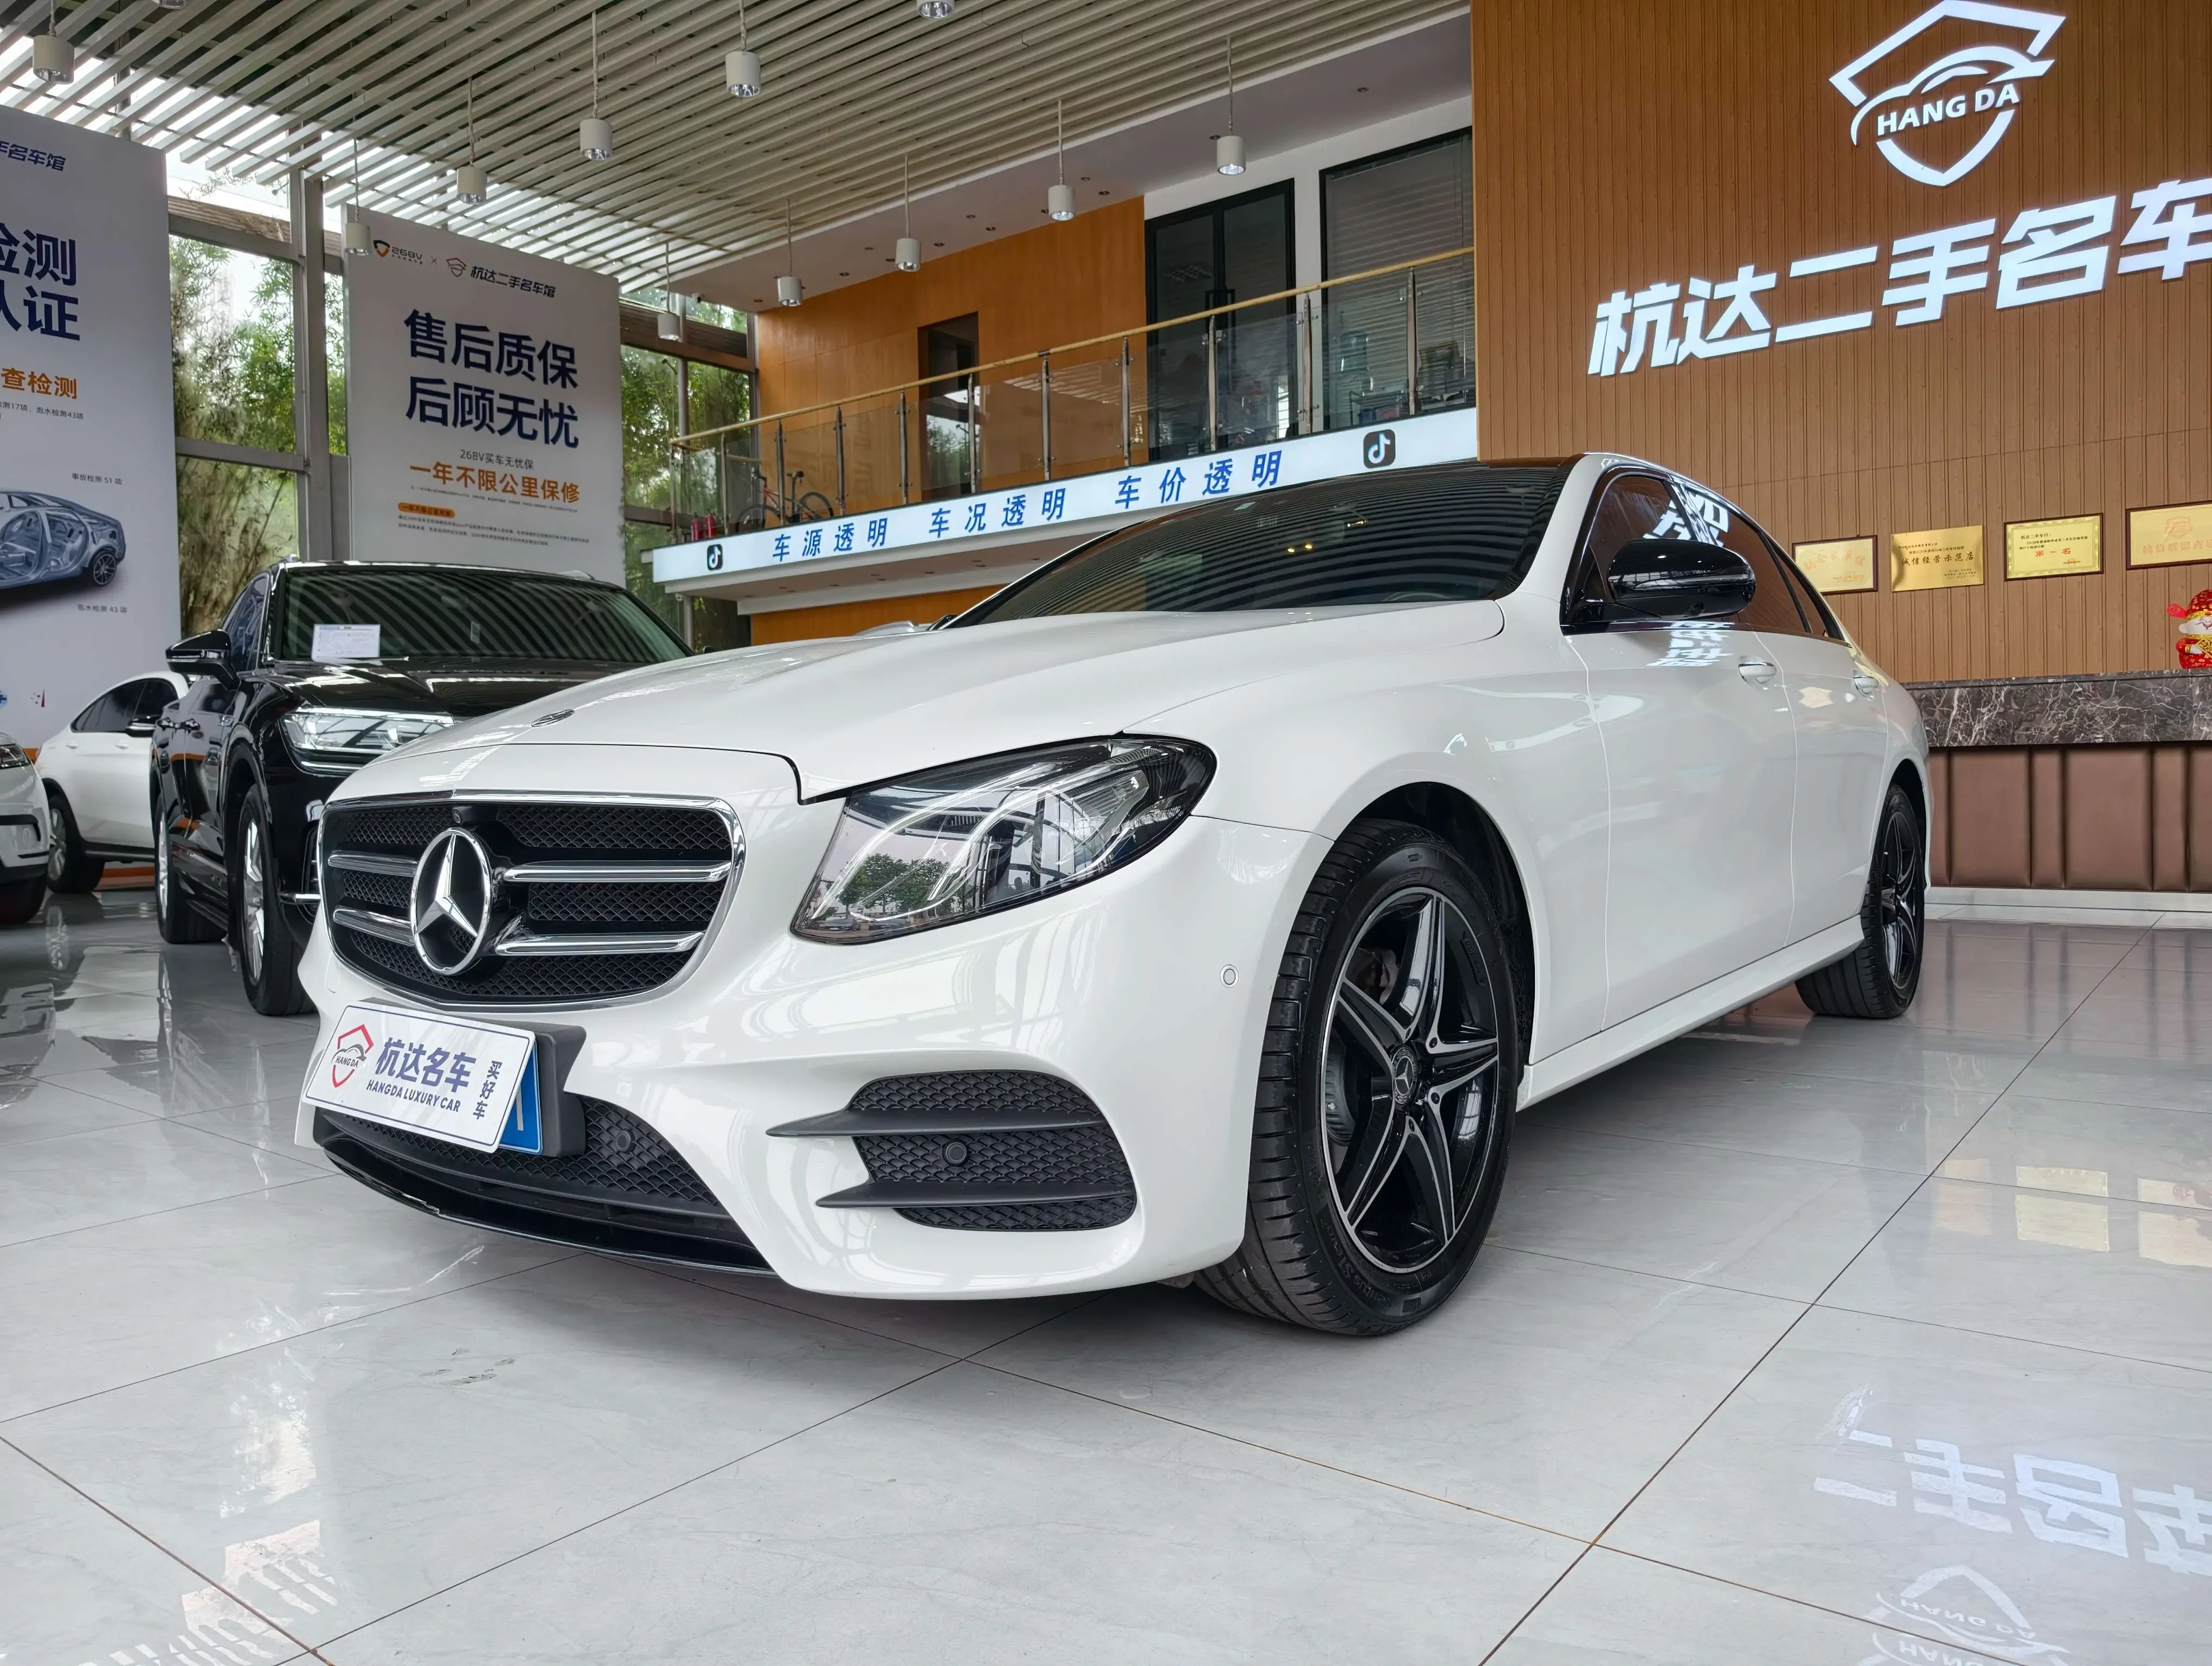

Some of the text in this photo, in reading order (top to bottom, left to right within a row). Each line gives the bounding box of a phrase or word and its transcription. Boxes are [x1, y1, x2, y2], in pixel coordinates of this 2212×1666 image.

[1877, 83, 2020, 136] HANG DA
[391, 246, 422, 260] 268V
[470, 265, 556, 298] 杭达二手名车馆
[1588, 178, 2212, 376] 杭达二手名车
[403, 308, 578, 389] 售后质保
[1, 367, 77, 399] 查检测
[405, 375, 579, 448] 后顾无忧
[410, 461, 580, 503] 一年不限公里保修
[460, 449, 534, 471] 268V买车无忧保
[773, 450, 1282, 562] 车源透明 车况透明 车价透明
[1902, 551, 1974, 566] 诚信经营示范店
[375, 1037, 477, 1093] 杭达名车
[366, 1079, 461, 1112] HANGDA LUXURY CAR
[473, 1060, 503, 1120] 买好车
